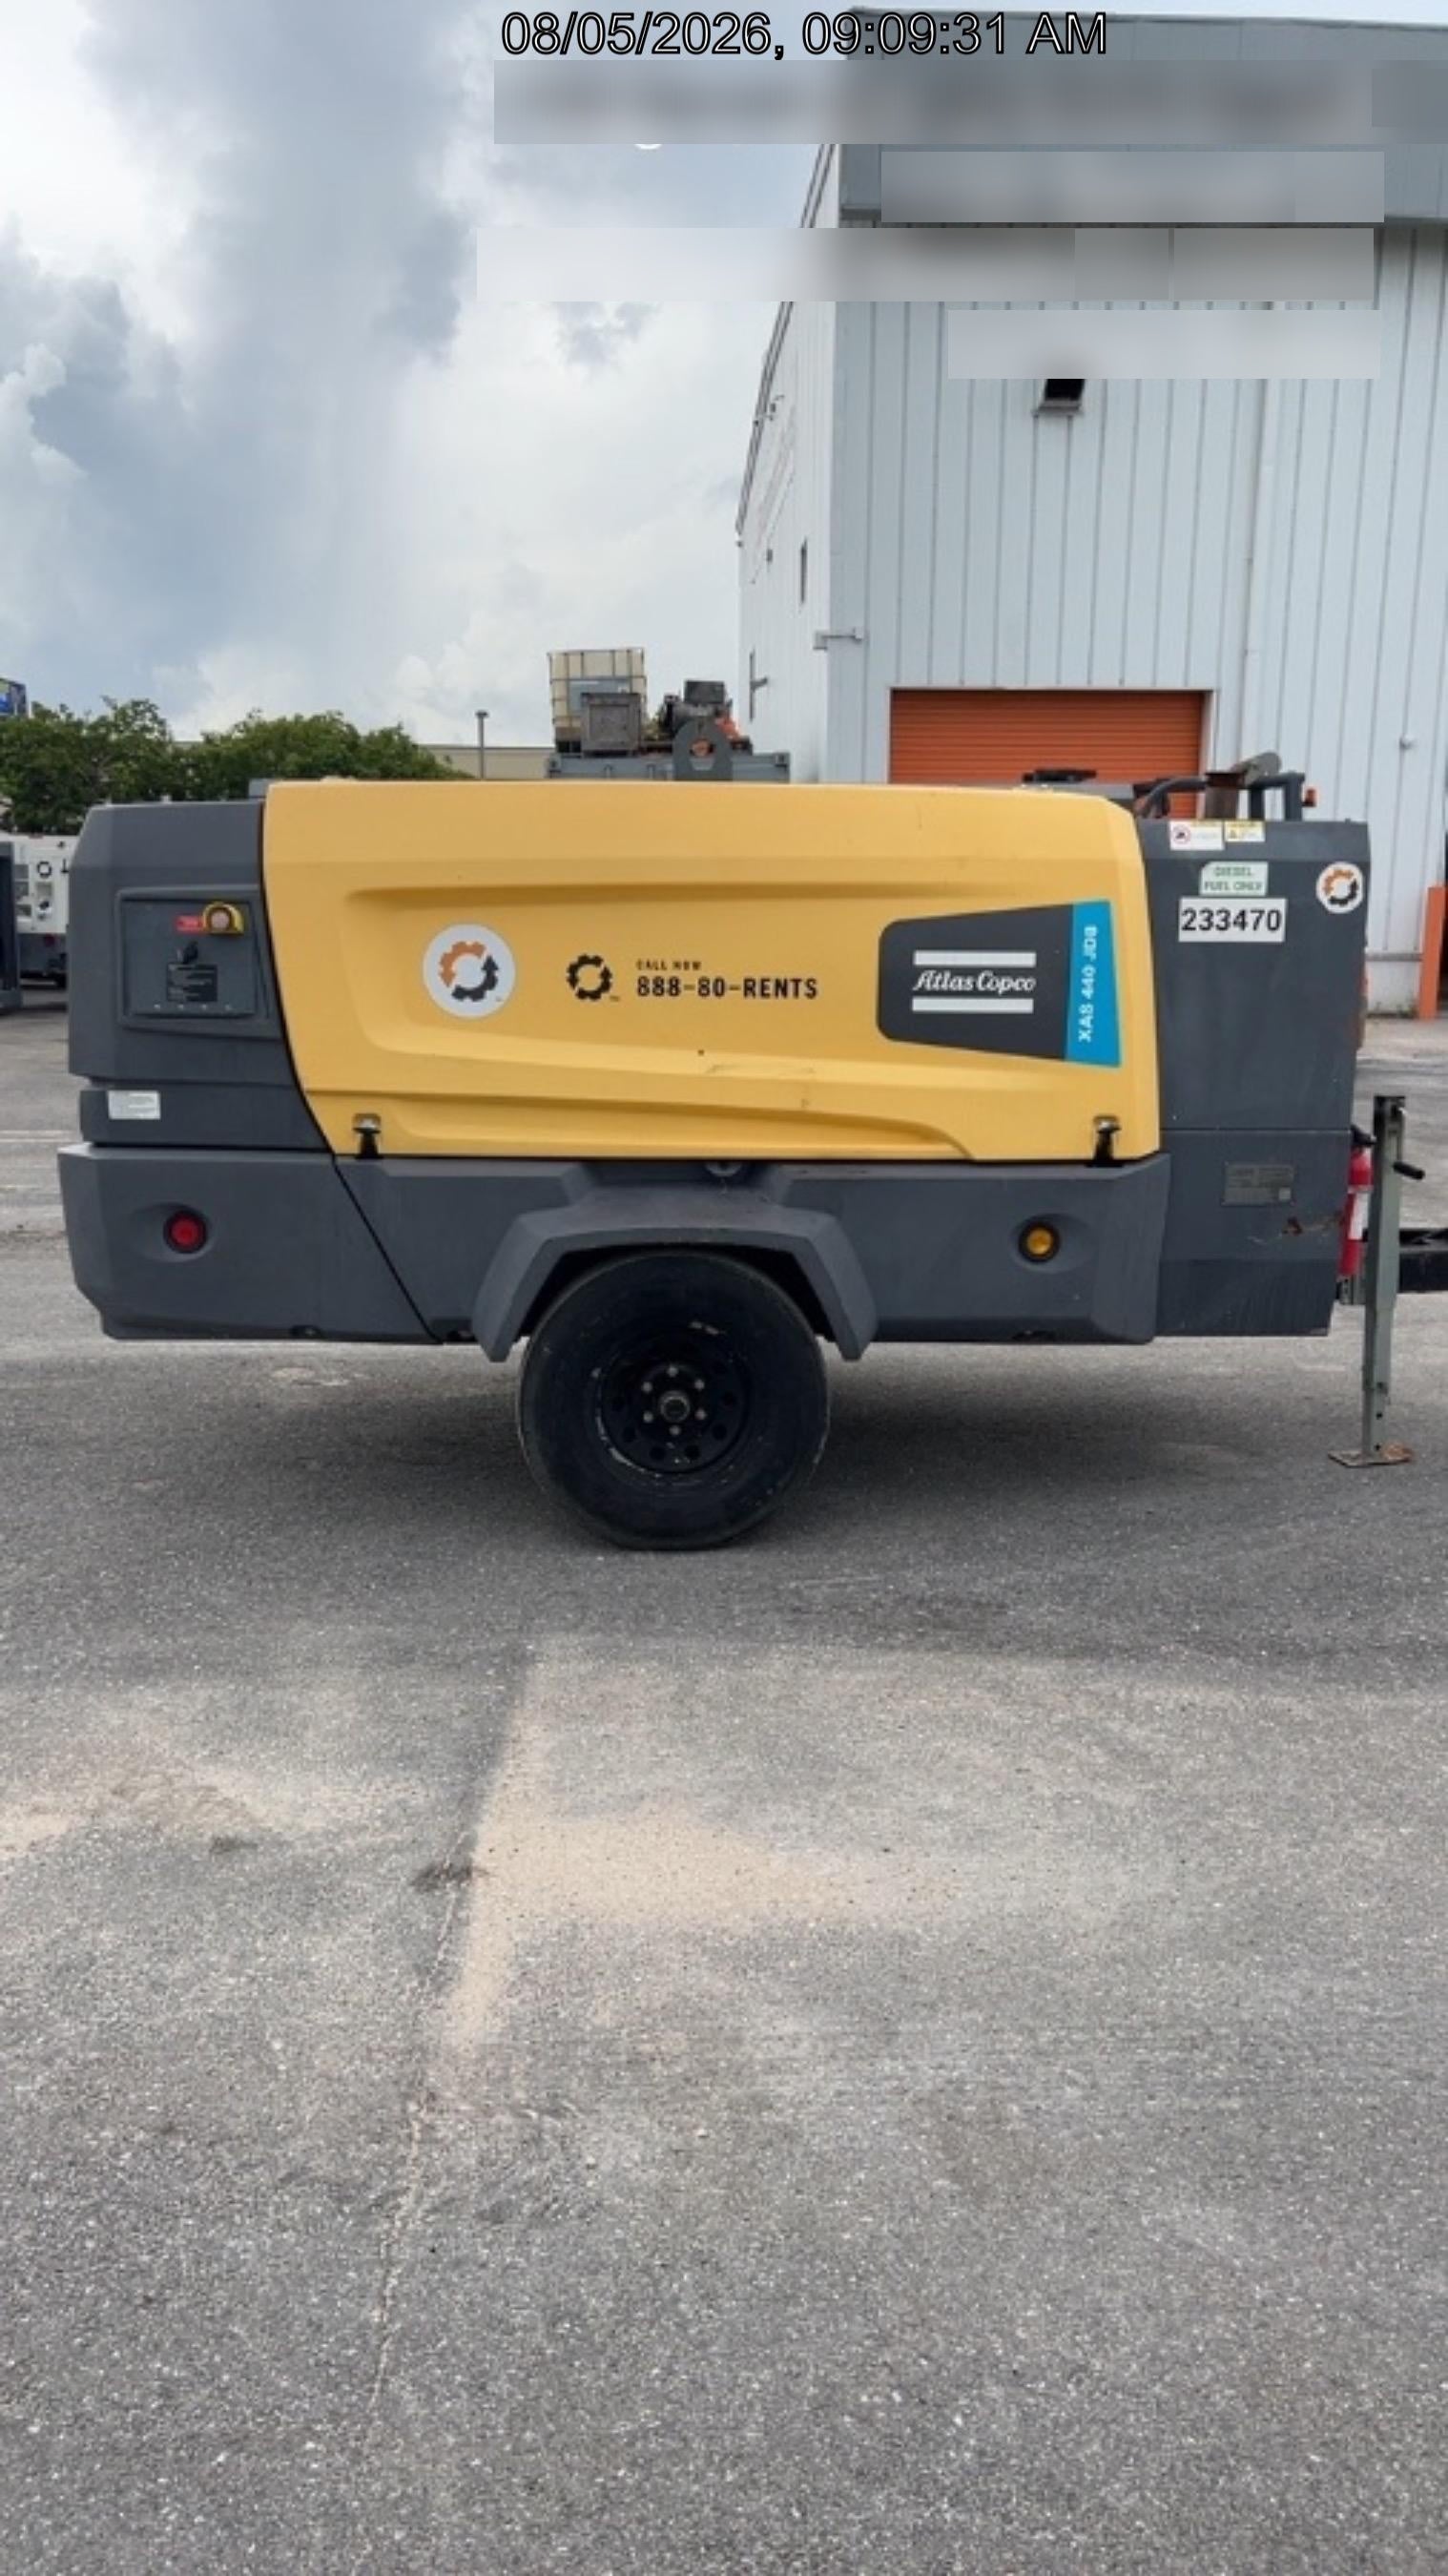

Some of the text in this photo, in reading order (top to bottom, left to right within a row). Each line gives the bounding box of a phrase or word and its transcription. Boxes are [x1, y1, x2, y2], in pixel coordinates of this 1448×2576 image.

[1213, 866, 1253, 877] DIESEL
[1204, 881, 1263, 891] FUEL ONLY
[1181, 908, 1282, 931] 233470
[635, 960, 702, 971] CALL NOW
[636, 975, 818, 1000] 888-80-RENTS
[913, 969, 1037, 995] Atlas Copco
[1081, 966, 1096, 999] 440
[1078, 1003, 1094, 1043] XAS
